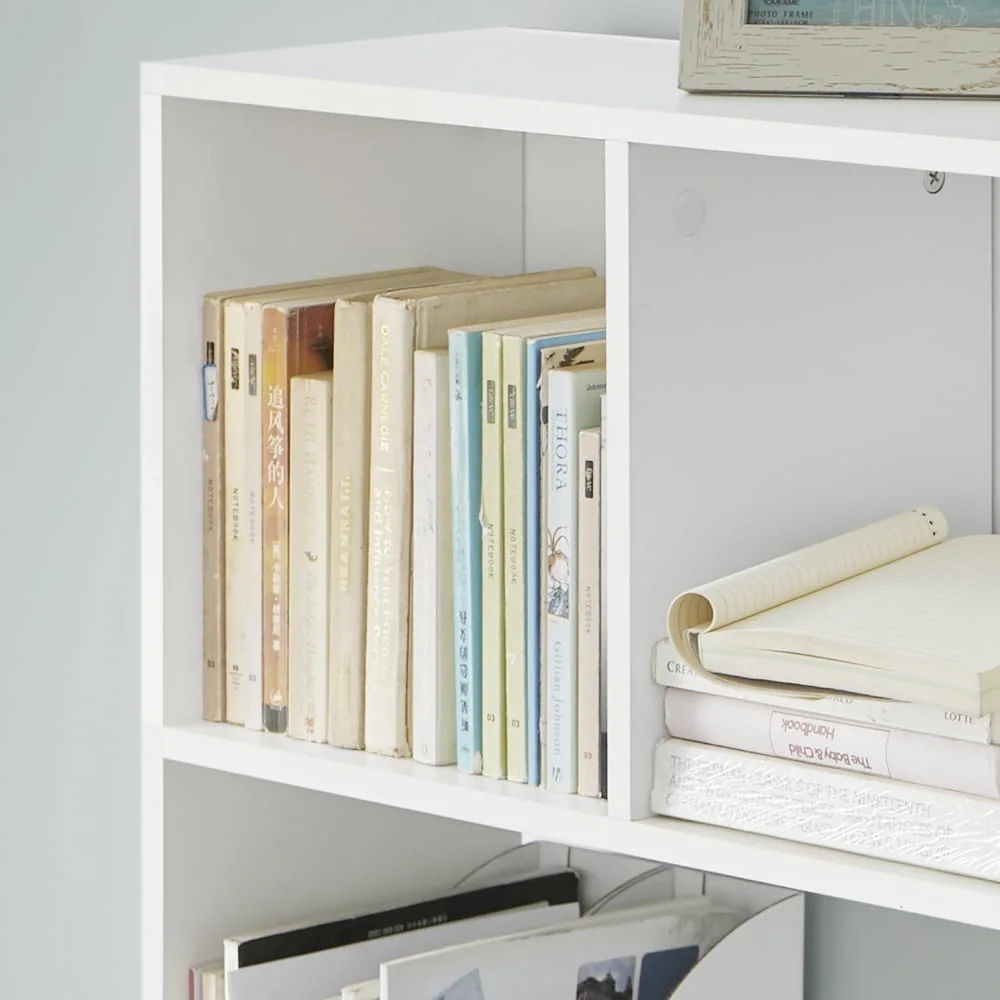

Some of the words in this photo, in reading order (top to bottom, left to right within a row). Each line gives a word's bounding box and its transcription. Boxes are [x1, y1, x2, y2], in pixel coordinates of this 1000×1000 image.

[784, 10, 816, 20] FRAME
[380, 324, 393, 369] DALE
[380, 371, 393, 454] CARNEGIE
[267, 385, 286, 509] 追风筝的人
[555, 408, 570, 493] THORA
[207, 478, 215, 533] NOTEBOOK
[231, 487, 239, 543] NOTEBOOK
[487, 523, 496, 580] NOTEBOOK
[510, 528, 518, 585] NOTEBOOK
[584, 585, 593, 636] NOTEBOOK
[552, 641, 565, 692] Gillian
[551, 695, 565, 755] Johnson
[781, 718, 836, 740] Handbook
[944, 711, 977, 725] LOTTE
[788, 743, 814, 759] Child
[814, 748, 824, 760] &
[823, 747, 850, 766] Baby
[850, 754, 873, 770] The
